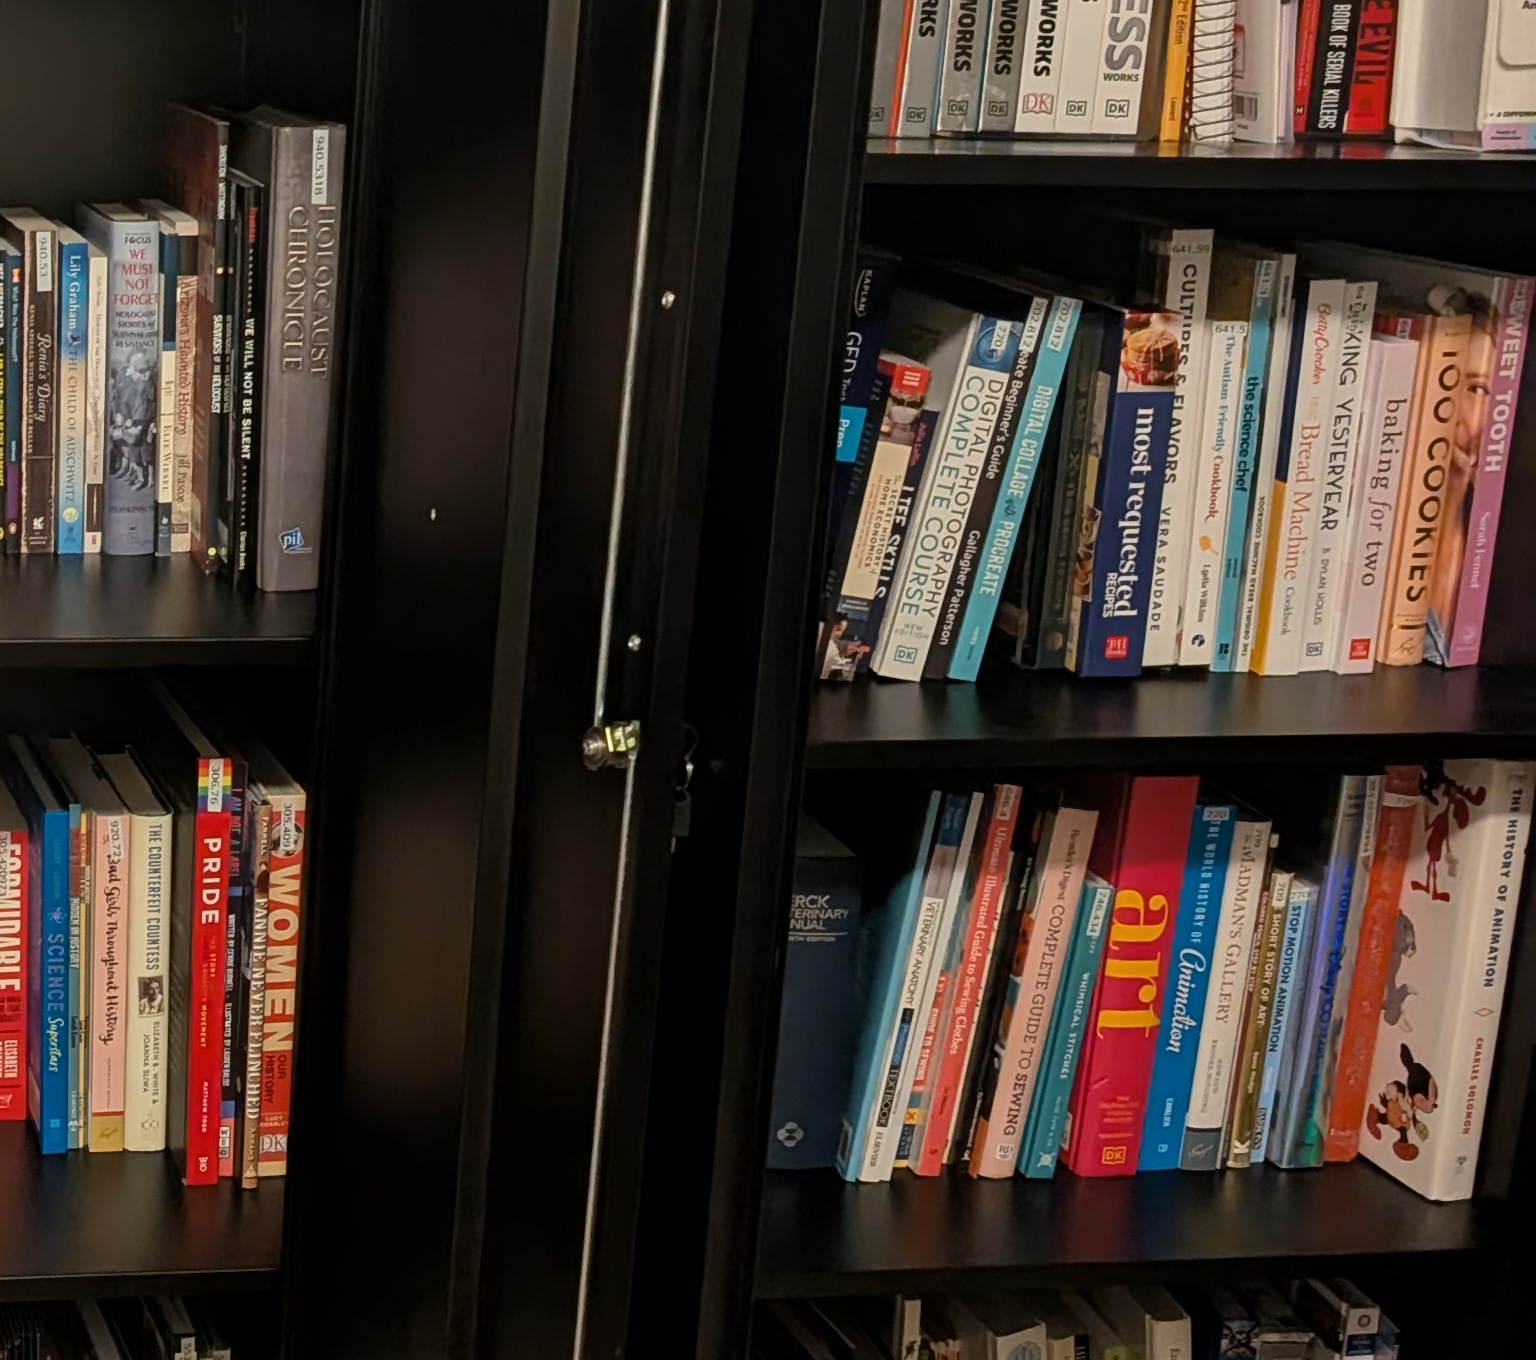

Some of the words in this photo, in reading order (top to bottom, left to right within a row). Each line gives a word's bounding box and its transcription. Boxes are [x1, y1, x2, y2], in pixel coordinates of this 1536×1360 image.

[1103, 73, 1140, 82] WORKS
[314, 136, 325, 196] 940.5318
[283, 206, 307, 372] CHRONICLE
[310, 204, 336, 377] HOLOCAUST
[1432, 351, 1461, 423] 100
[1130, 407, 1155, 476] most
[1370, 398, 1408, 491] baking
[1487, 391, 1513, 474] TOOTH
[1114, 483, 1146, 618] requested
[1367, 498, 1392, 533] for
[1407, 436, 1452, 602] COOKIES
[1102, 572, 1118, 619] RECIPES
[1361, 541, 1384, 587] two
[209, 765, 220, 805] 306.76
[201, 837, 222, 925] PRIDE
[262, 864, 301, 1050] WOMEN
[1098, 888, 1170, 1039] art
